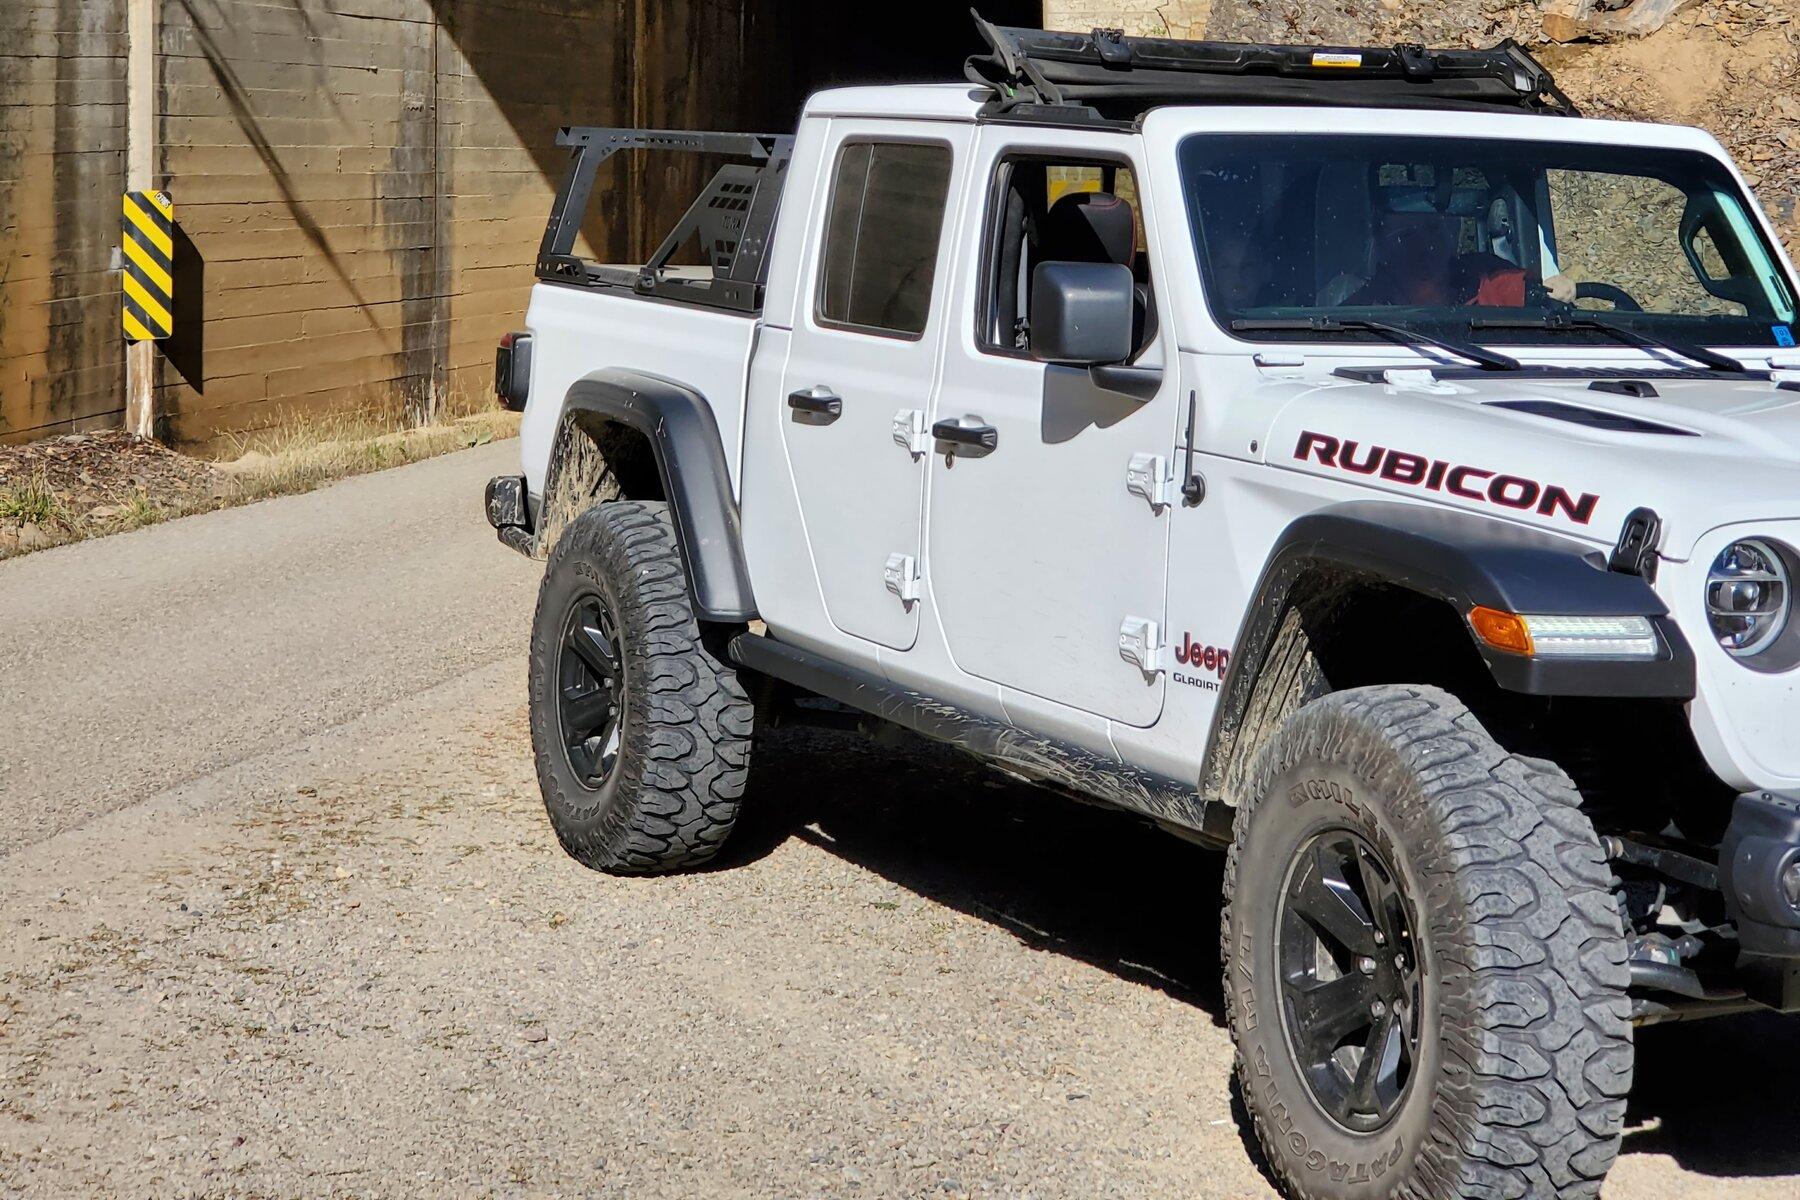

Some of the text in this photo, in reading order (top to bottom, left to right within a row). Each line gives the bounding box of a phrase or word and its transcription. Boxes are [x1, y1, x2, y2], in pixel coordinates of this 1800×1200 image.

[1293, 430, 1600, 525] RUBICON
[1175, 631, 1231, 680] Jeep
[1254, 1045, 1404, 1185] PATAGONIA
